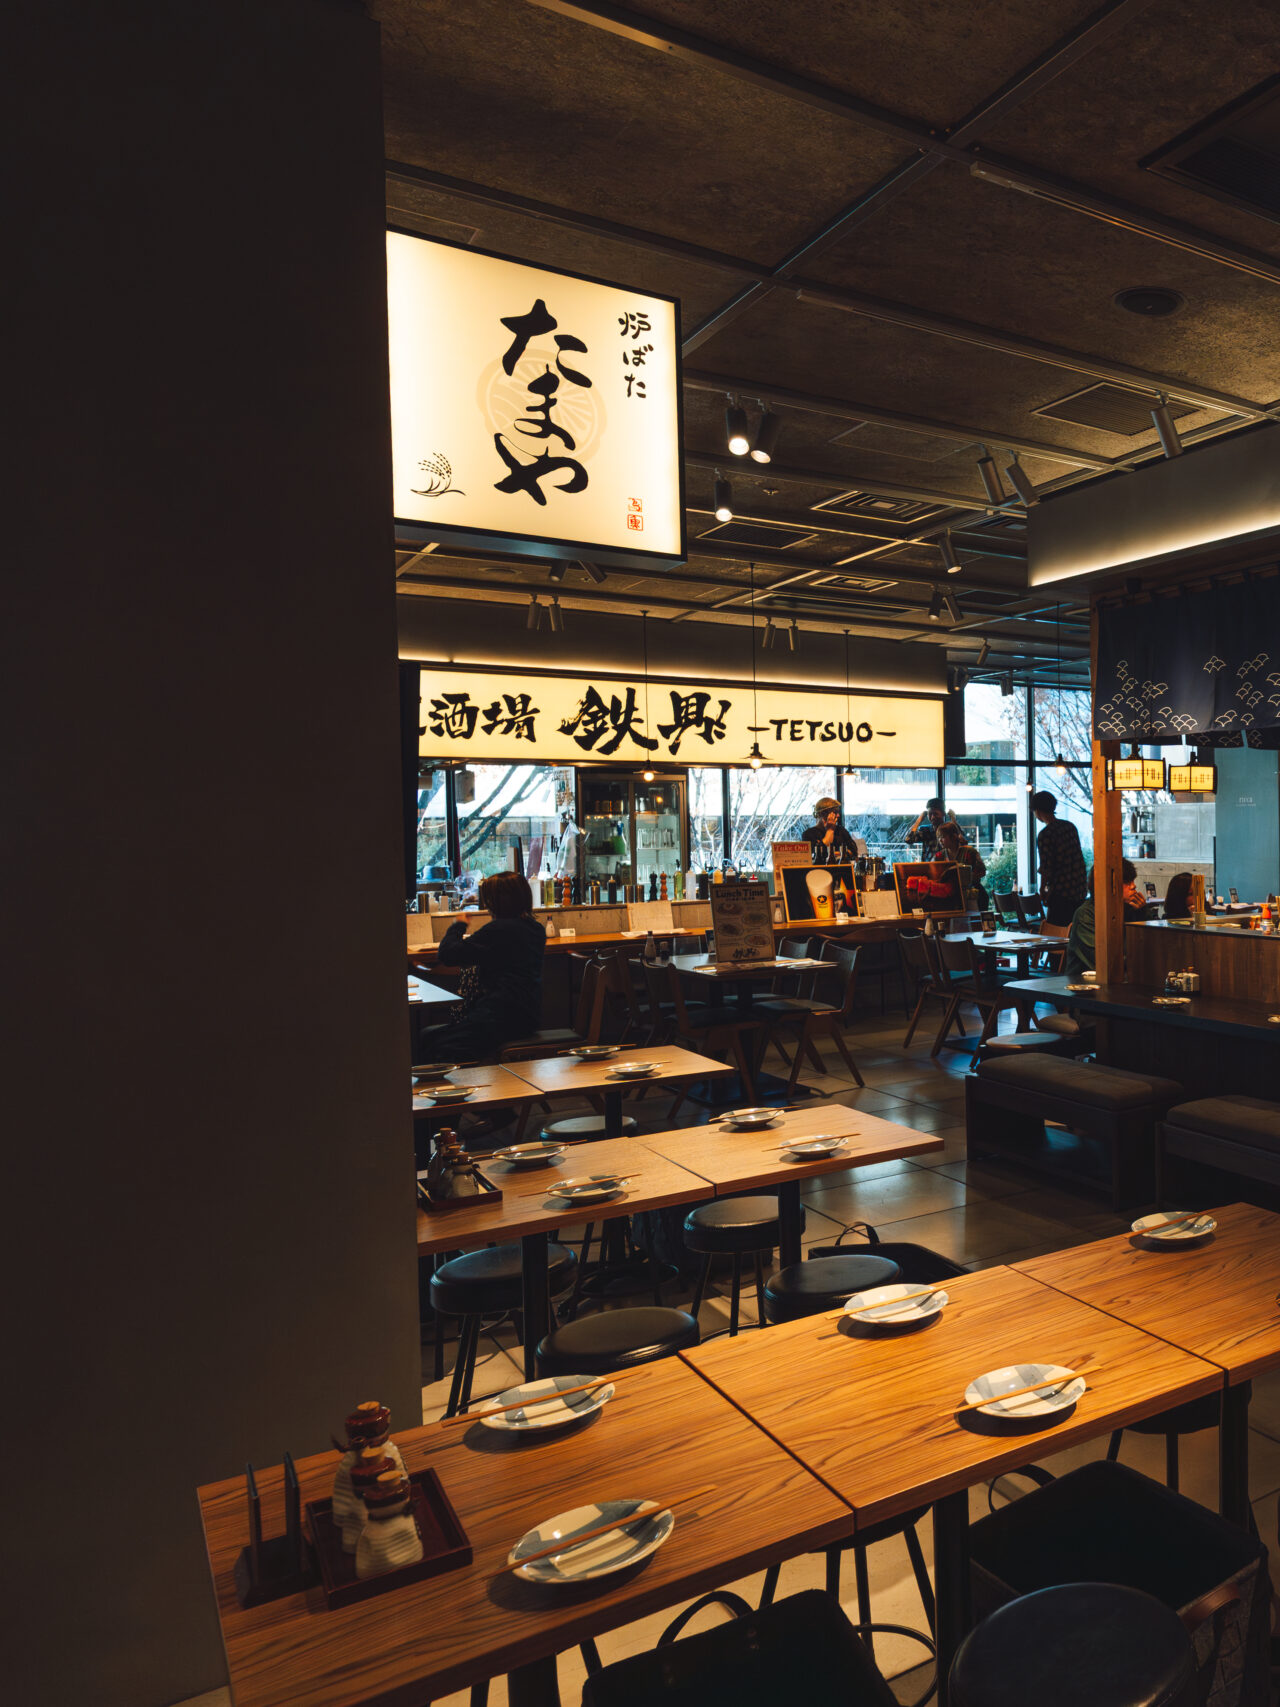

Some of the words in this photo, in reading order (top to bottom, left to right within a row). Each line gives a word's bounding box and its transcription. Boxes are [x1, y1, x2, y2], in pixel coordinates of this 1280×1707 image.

[617, 311, 655, 400] 炉ばた
[493, 298, 593, 507] たまや
[418, 692, 541, 743] 酒場
